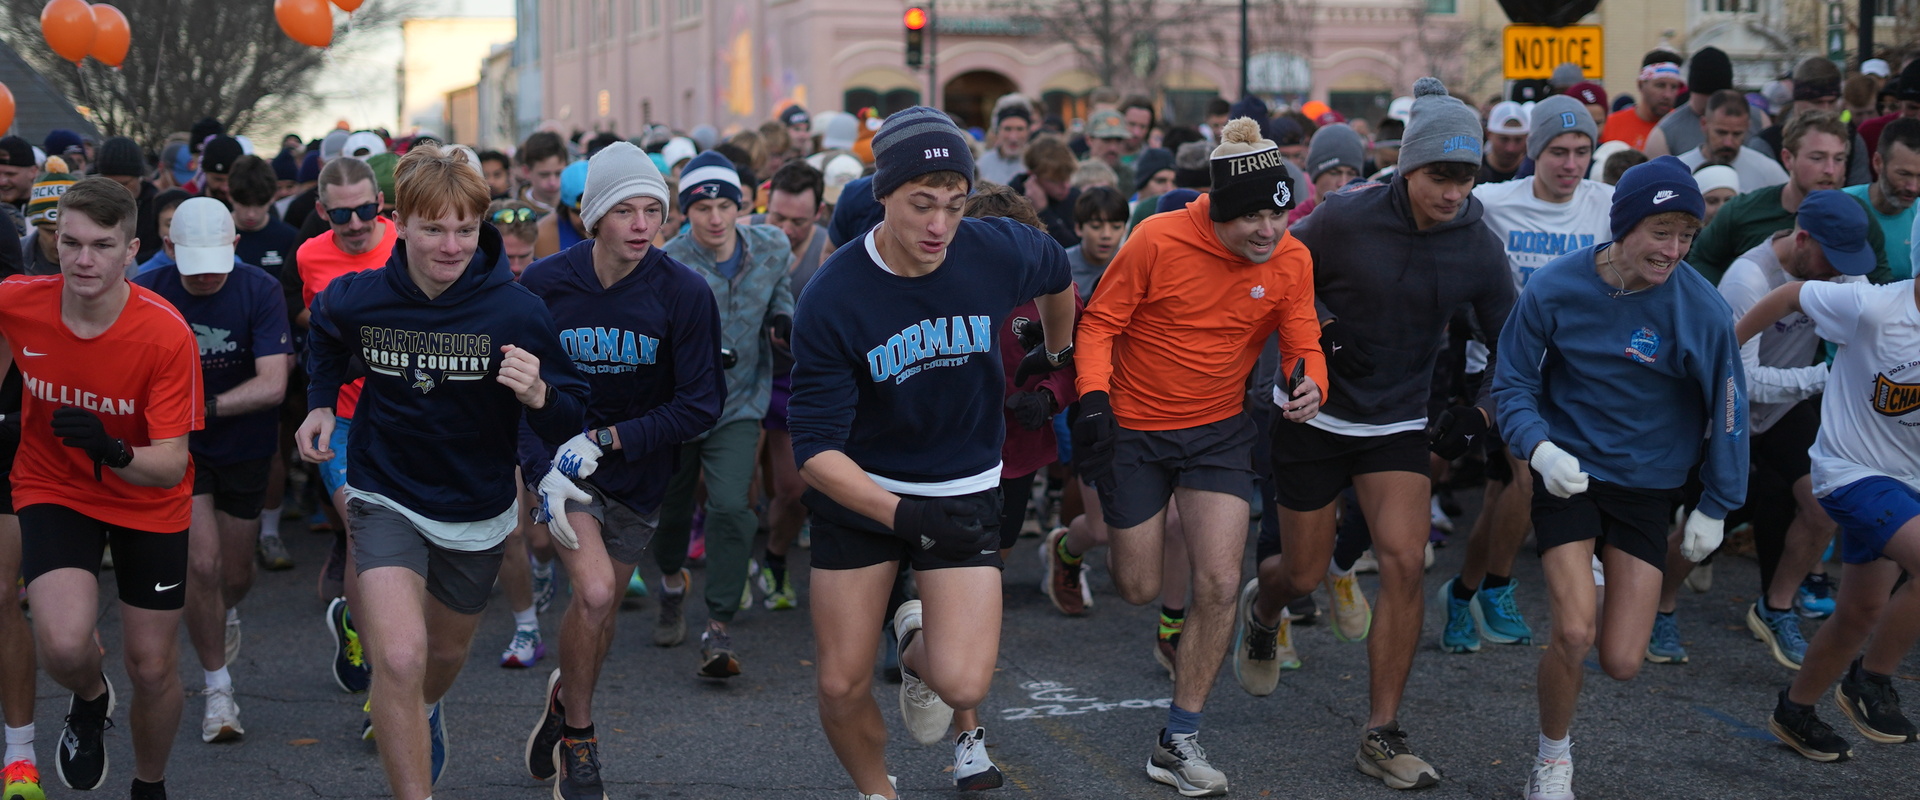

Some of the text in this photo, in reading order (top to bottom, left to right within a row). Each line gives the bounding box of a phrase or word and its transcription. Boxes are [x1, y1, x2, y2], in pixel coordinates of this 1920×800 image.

[1514, 37, 1592, 70] NOTICE
[1560, 112, 1576, 128] D
[924, 148, 949, 159] DHS
[33, 185, 69, 198] ACKE
[1656, 190, 1674, 198] NIKE
[1508, 230, 1595, 256] DORMAN
[360, 325, 491, 357] SPARTANBURG
[559, 327, 660, 365] ORMAN
[867, 315, 992, 383] DORMAN
[362, 347, 491, 371] CROSS COUNTRY
[597, 364, 638, 375] COUNTRY
[895, 355, 970, 386] CROSS COUNTRY
[1888, 360, 1920, 377] 2025 TO
[23, 371, 135, 415] MILLIGAN
[1726, 376, 1735, 433] CHAMPIONSHIPS
[1889, 387, 1920, 410] CHA
